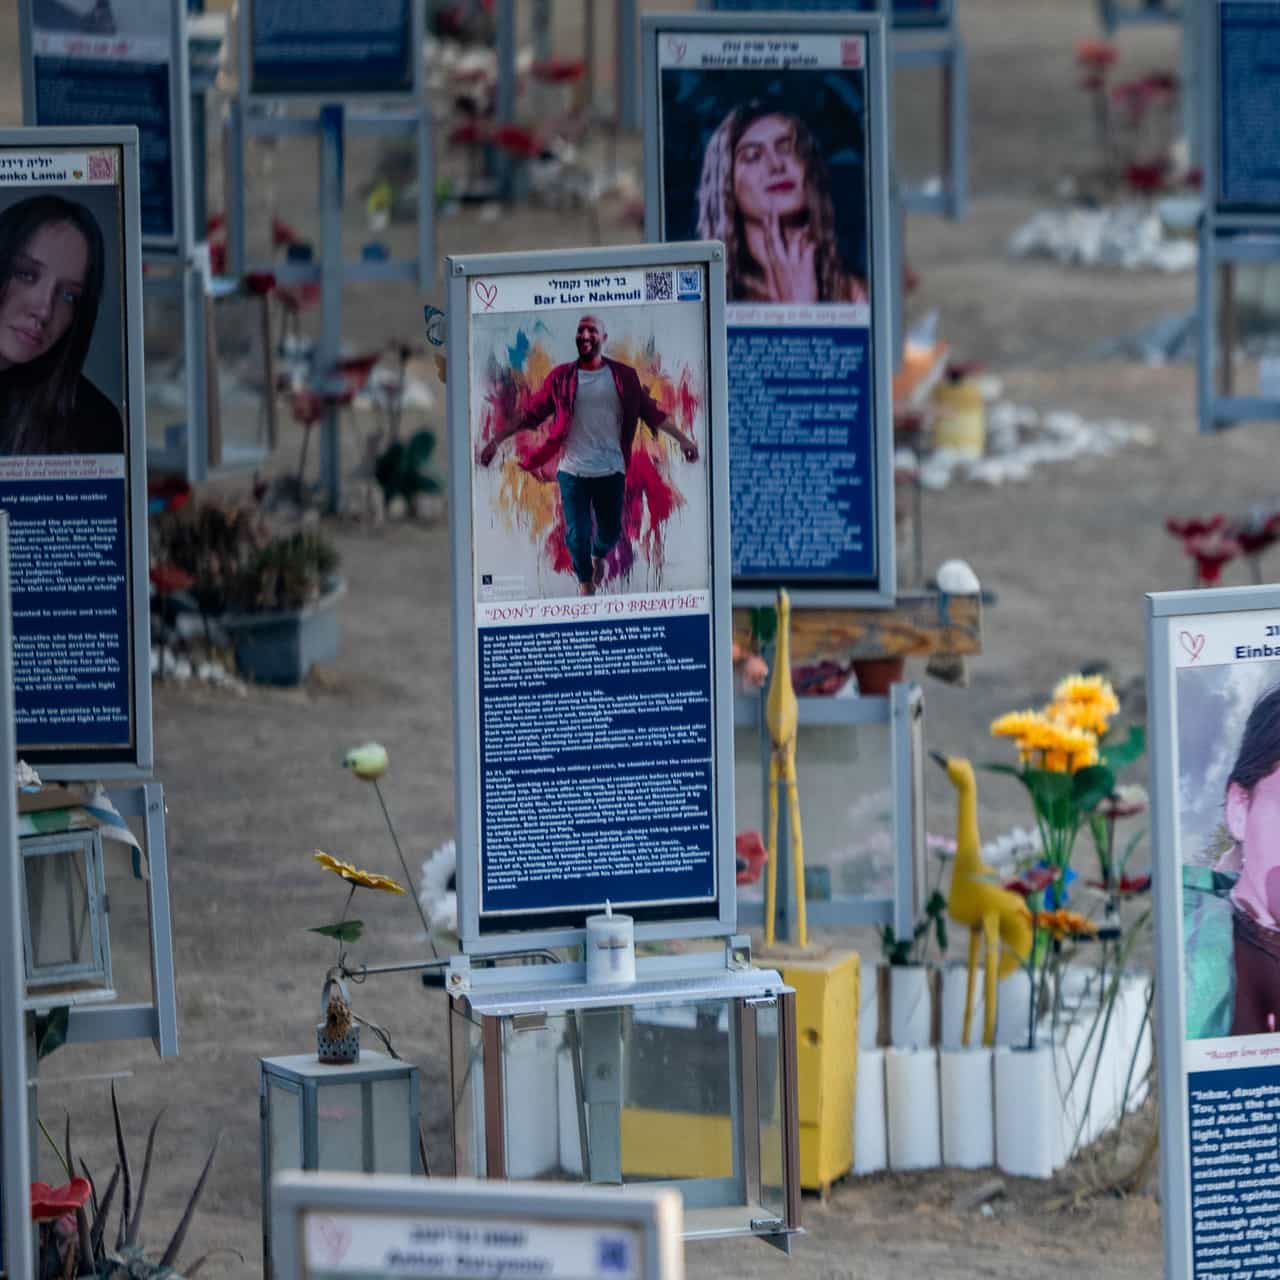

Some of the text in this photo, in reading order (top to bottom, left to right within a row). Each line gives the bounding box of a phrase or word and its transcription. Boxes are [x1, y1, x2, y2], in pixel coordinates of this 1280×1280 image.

[549, 276, 626, 289] בר ליאור נקמולי
[534, 290, 641, 305] Bar Lior Nakmuli
[486, 595, 707, 620] "DON'T FORGET TO BREATHE"
